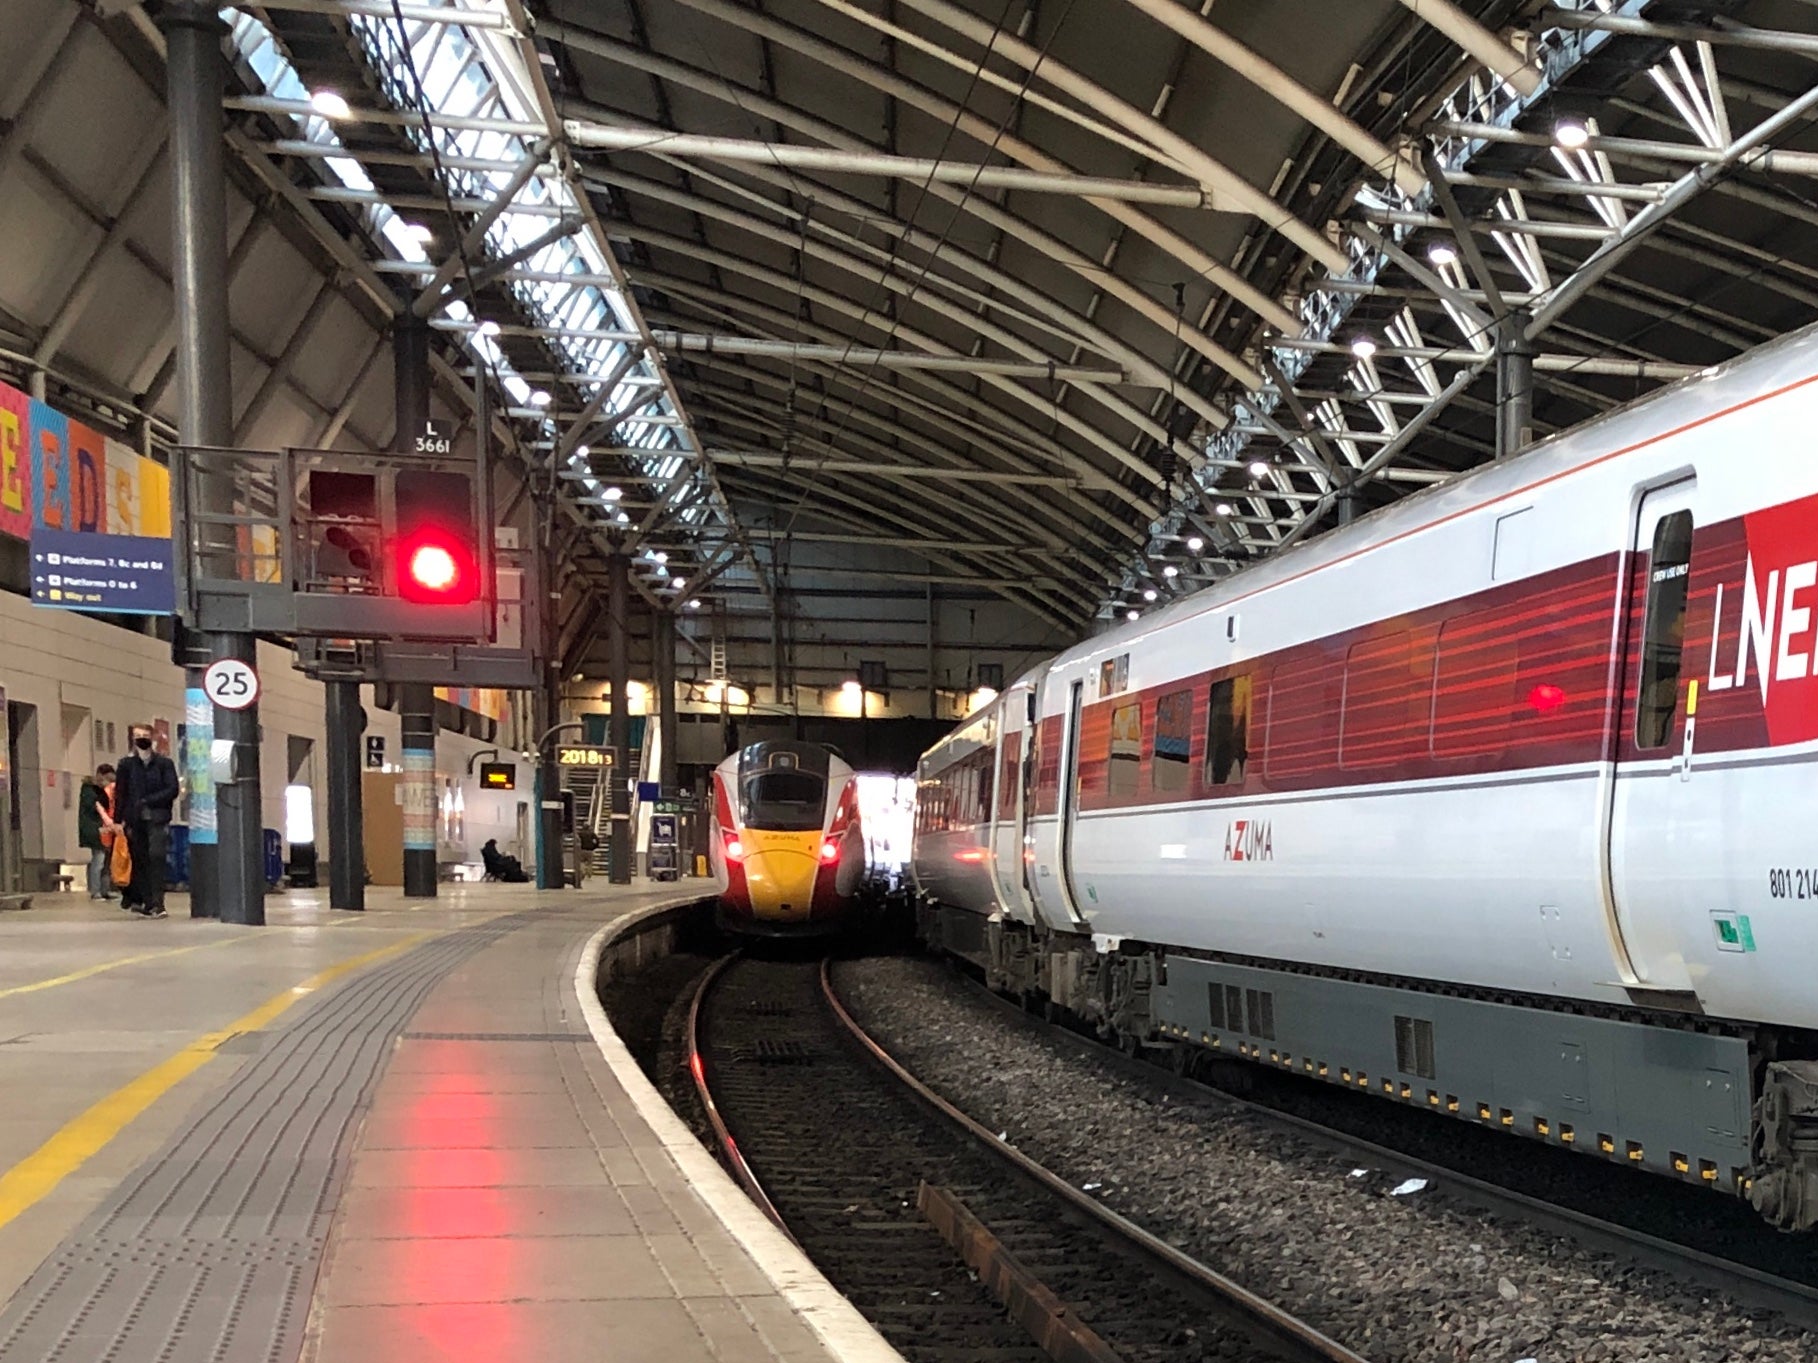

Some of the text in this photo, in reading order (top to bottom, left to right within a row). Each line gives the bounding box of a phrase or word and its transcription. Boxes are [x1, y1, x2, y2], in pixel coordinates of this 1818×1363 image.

[426, 421, 438, 436] L
[415, 437, 450, 453] 3661
[62, 555, 107, 568] Platforms
[132, 561, 149, 570] and
[63, 576, 108, 588] Platforms
[215, 672, 248, 696] 25
[1223, 819, 1274, 862] AZUMA
[1769, 868, 1793, 899] 801
